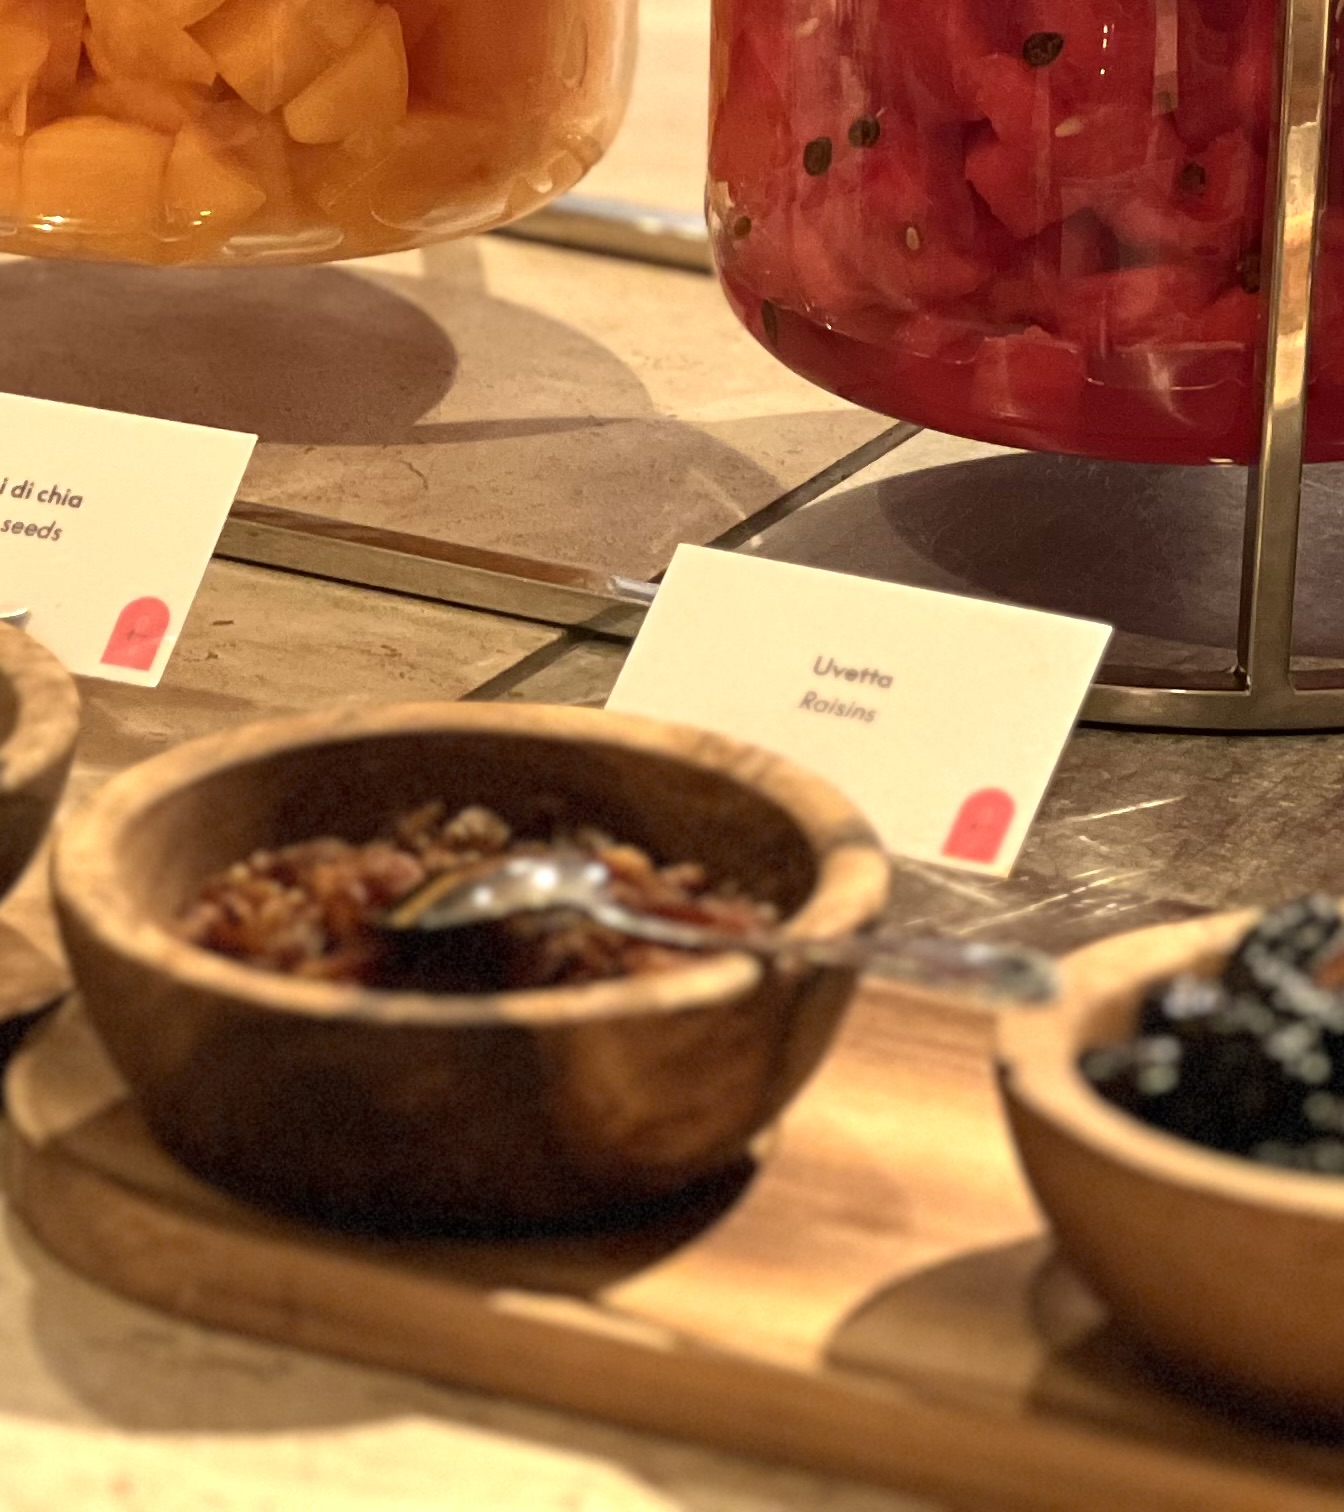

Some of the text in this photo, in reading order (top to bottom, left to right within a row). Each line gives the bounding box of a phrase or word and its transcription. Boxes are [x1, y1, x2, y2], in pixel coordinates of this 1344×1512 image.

[10, 480, 35, 499] di
[37, 484, 83, 508] chia
[0, 519, 63, 541] seeds
[813, 655, 893, 688] Uvetta
[799, 690, 877, 723] Raisins
